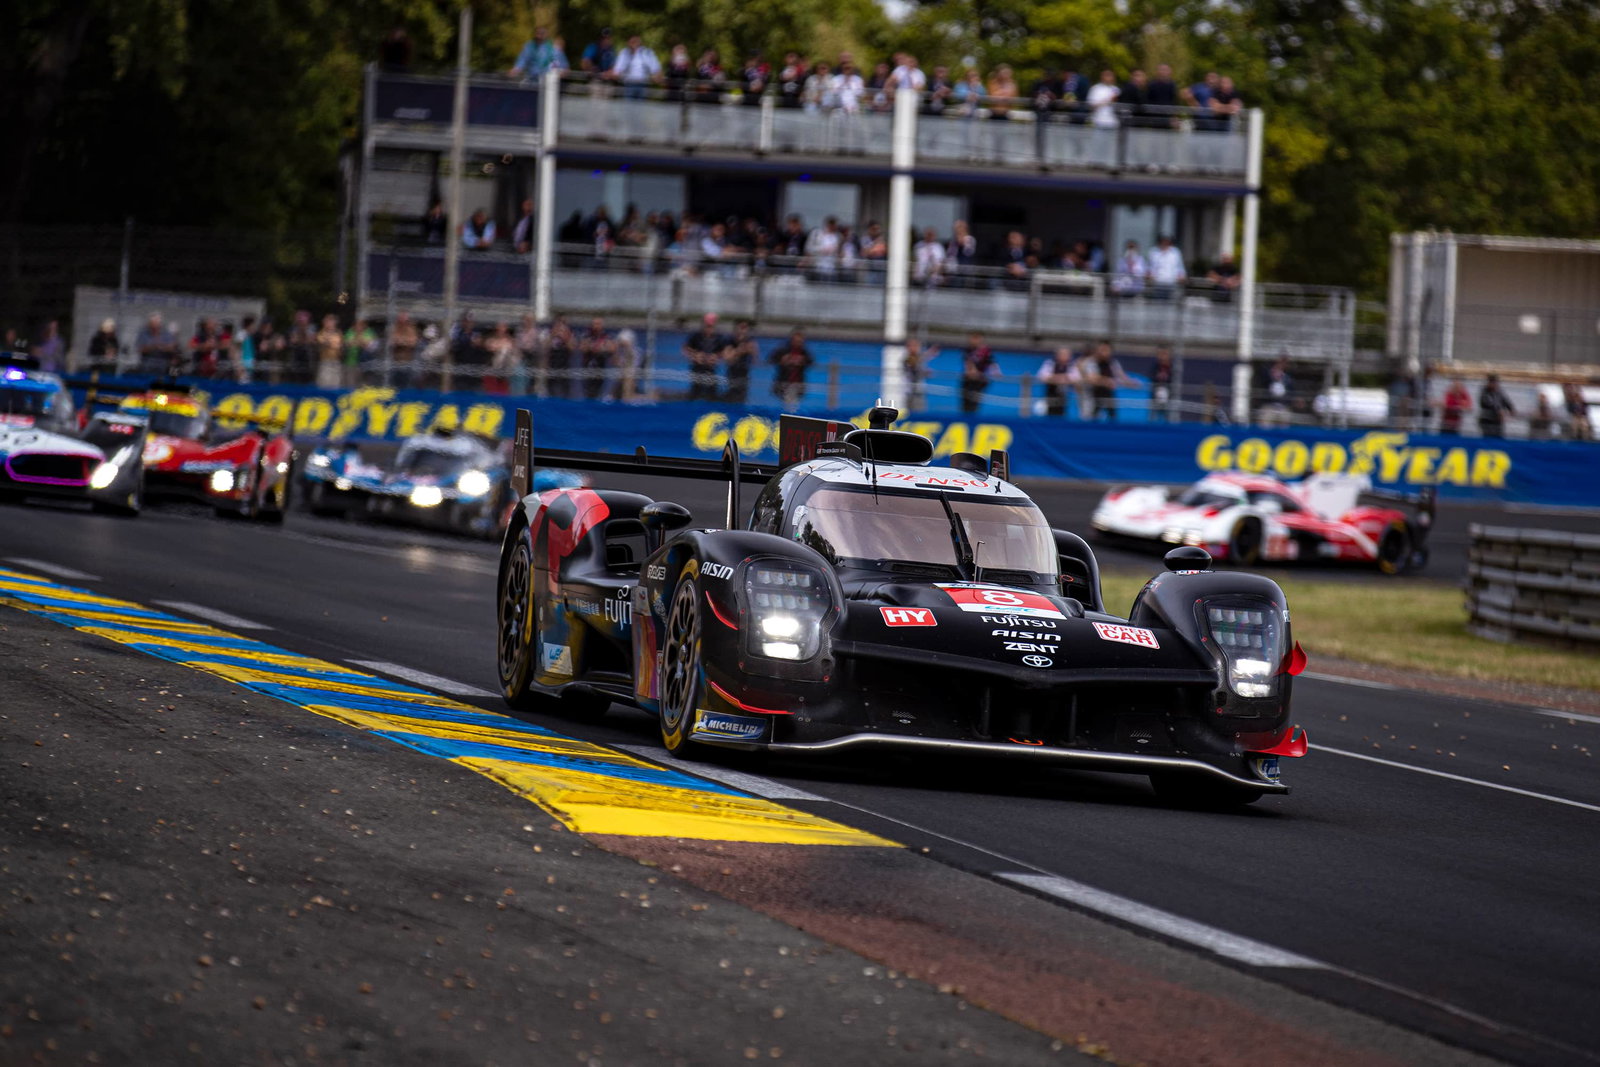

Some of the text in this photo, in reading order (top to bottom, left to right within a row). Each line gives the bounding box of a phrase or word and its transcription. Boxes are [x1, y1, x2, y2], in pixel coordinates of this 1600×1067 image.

[194, 387, 504, 440] OODYEAR
[515, 427, 529, 447] JFE
[1196, 432, 1512, 487] GOODYEAR
[879, 472, 989, 488] DENSO
[701, 561, 734, 580] AISIN
[981, 590, 1024, 606] 8
[885, 610, 927, 623] HY
[981, 615, 1057, 628] FUJITSU
[991, 629, 1062, 641] AISIN
[1099, 624, 1148, 635] HYPER
[1103, 629, 1153, 645] CAR
[1003, 641, 1059, 654] ZENT
[707, 720, 758, 734] MICHELIN
